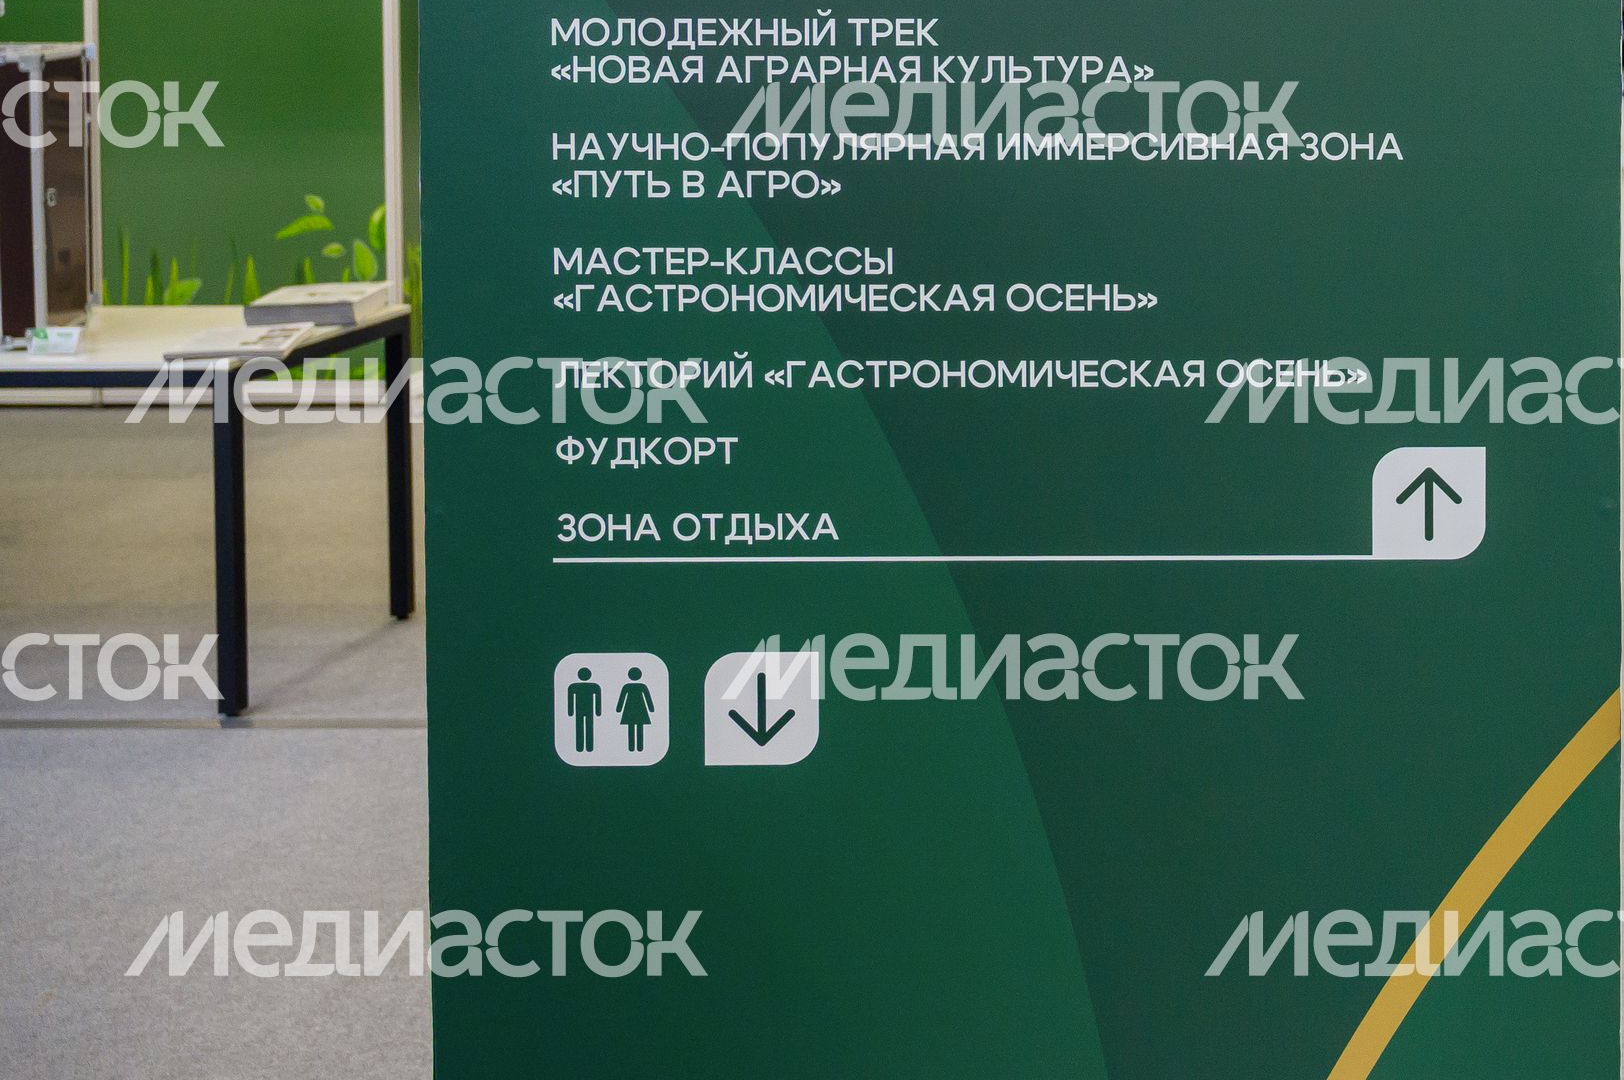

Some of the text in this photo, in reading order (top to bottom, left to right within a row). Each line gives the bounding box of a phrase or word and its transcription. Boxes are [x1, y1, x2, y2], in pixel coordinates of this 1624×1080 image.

[551, 9, 939, 50] МОЛОДЕЖНЫЙ ТРЕК
[550, 55, 1154, 84] «НОВАЯ АГРАРНАЯ КУЛЬТУРА»
[552, 132, 1404, 161] НАУЧНО-ПОПУЛЯРНАЯ ИММЕРСИВНАЯ ЗОНА
[552, 170, 842, 199] «ПУТЬ В АГРО»
[553, 247, 893, 276] МАСТЕР-КЛАССЫ
[553, 283, 1158, 312] «ГАСТРОНОМИЧЕСКАЯ ОСЕНЬ»
[555, 351, 1368, 389] ЛЕКТОРИЙ «ГАСТРОНОМИЧЕСКАЯ ОСЕНЬ»
[556, 436, 739, 469] ФУДКОРТ
[557, 513, 840, 545] ЗОНА ОТДЫХА
